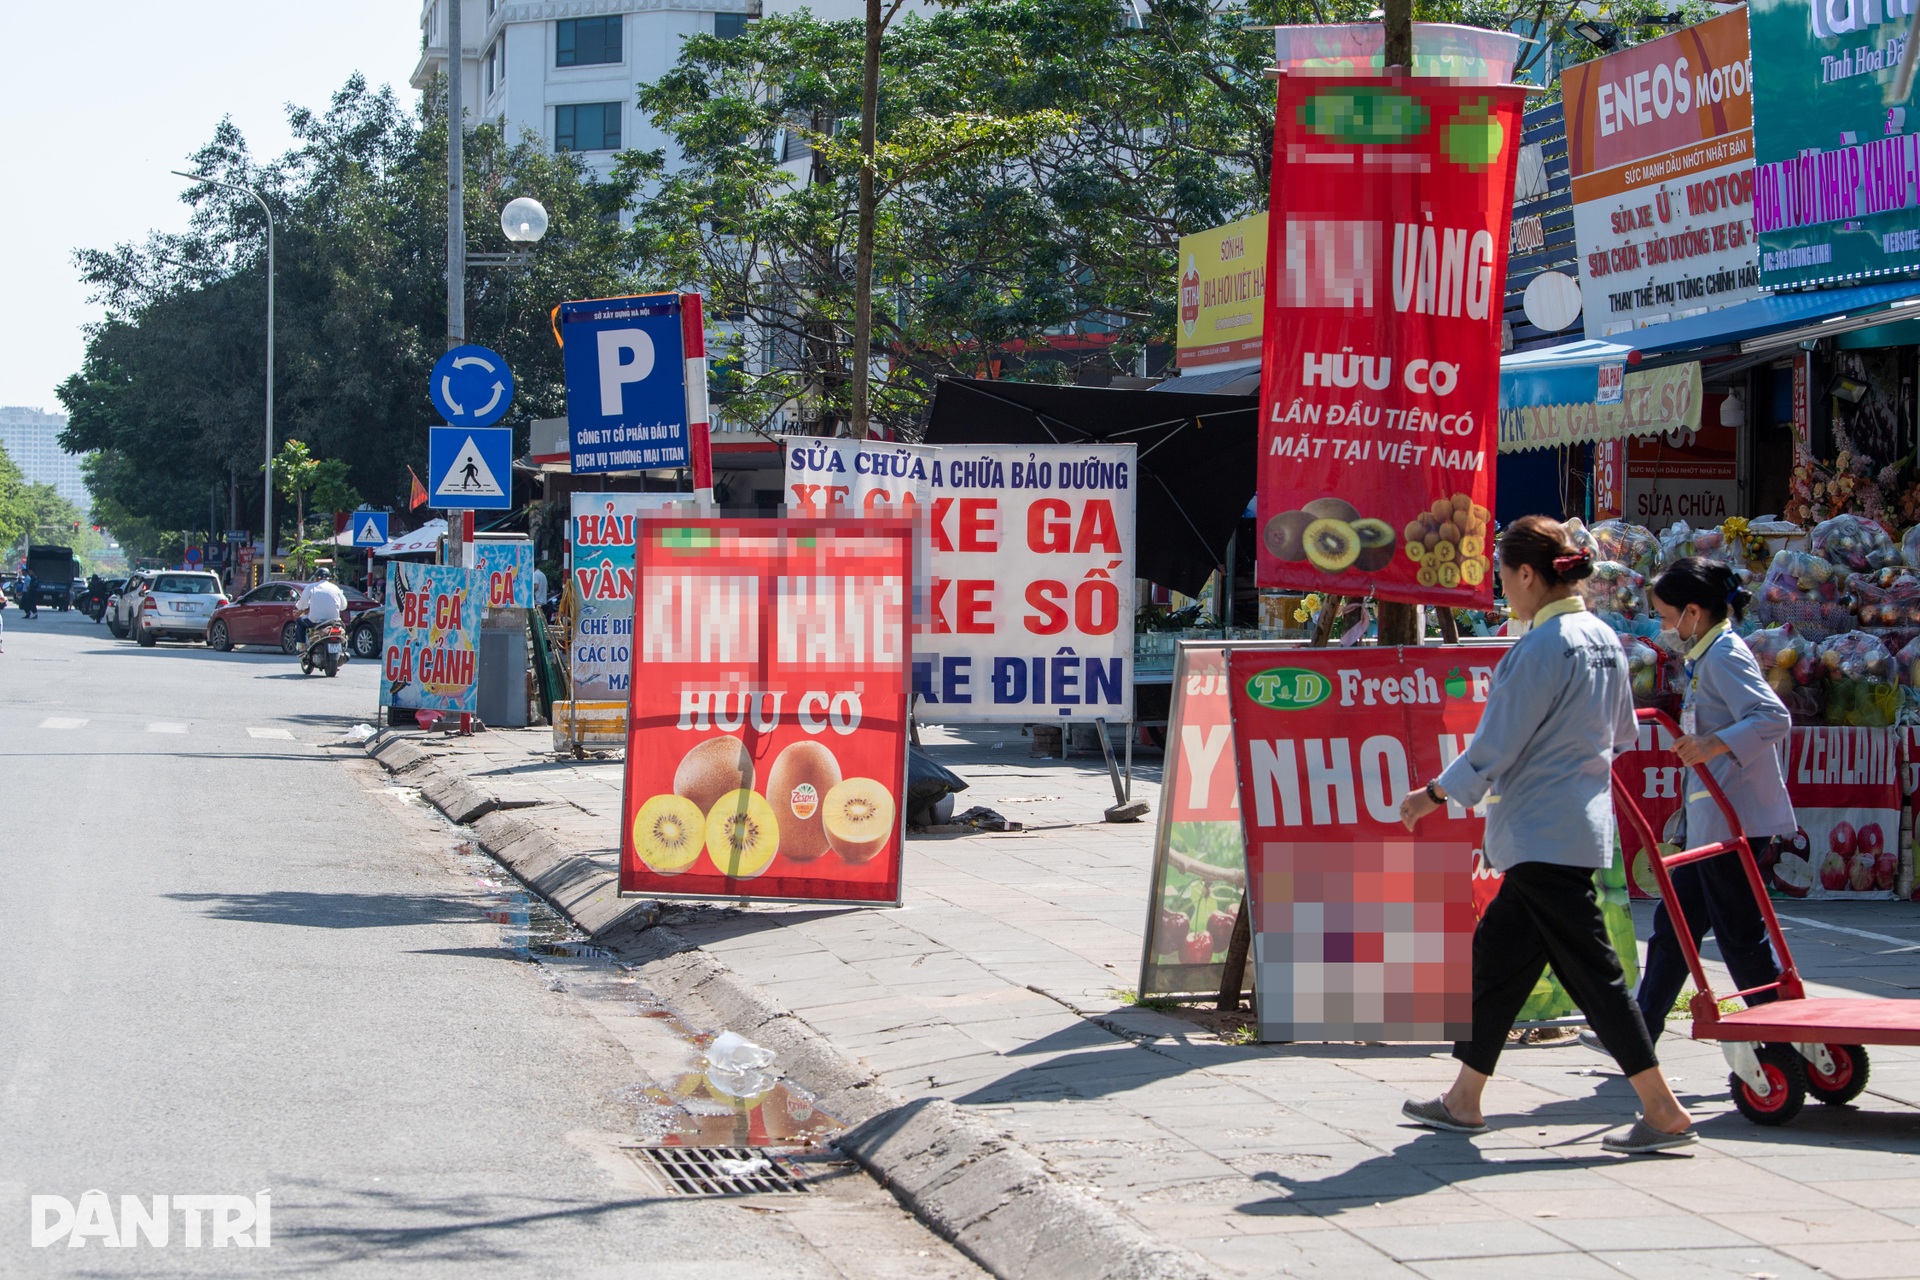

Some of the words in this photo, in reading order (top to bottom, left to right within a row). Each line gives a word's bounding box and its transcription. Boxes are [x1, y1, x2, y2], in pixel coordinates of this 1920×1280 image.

[1821, 48, 1854, 84] Tinh
[1854, 45, 1883, 76] Hoa
[1597, 56, 1691, 137] ENEOS
[1625, 165, 1642, 185] SỨC
[1642, 162, 1665, 182] MẠNH
[1665, 153, 1682, 174] DẦU
[1682, 147, 1705, 169] NHỚT
[1706, 142, 1728, 163] NHẬT
[1729, 136, 1747, 156] BẢN
[1752, 162, 1783, 233] HOA
[1783, 148, 1818, 228] TƯƠI
[1818, 131, 1861, 231] NHẬP
[1611, 204, 1636, 235] SỬA
[1636, 204, 1653, 230] XE
[1391, 210, 1493, 321] VÀNG
[1588, 245, 1611, 279] SỬA
[1611, 239, 1641, 273] CHỮA
[1646, 232, 1669, 266] BẢO
[1668, 225, 1710, 261] DƯỠNG
[1710, 224, 1728, 252] XE
[1728, 220, 1747, 249] GA
[1203, 278, 1216, 308] BIA
[1608, 291, 1634, 313] THAY
[1634, 276, 1656, 308] THẾ
[1655, 282, 1675, 307] PHỤ
[1676, 273, 1704, 301] TÙNG
[1705, 266, 1736, 295] CHÍNH
[596, 328, 656, 416] P
[1302, 346, 1391, 391] HỮU
[1404, 358, 1460, 396] CƠ
[1270, 396, 1322, 424] LẦN
[1325, 399, 1381, 427] ĐẦU
[1385, 406, 1438, 433] TIÊN
[1439, 411, 1475, 436] CÓ
[1531, 404, 1561, 441] XE
[1566, 401, 1600, 436] GA
[1618, 385, 1653, 430] XE
[1660, 361, 1692, 425] SỐ
[577, 428, 601, 446] CÔNG
[601, 429, 612, 444] TY
[613, 423, 625, 443] CỔ
[626, 422, 649, 442] PHẦN
[650, 421, 668, 440] ĐẦU
[668, 422, 680, 439] TƯ
[1269, 433, 1327, 463] MẶT
[1331, 438, 1371, 466] TẠI
[1377, 440, 1428, 470] VIỆT
[1431, 446, 1485, 472] NAM
[576, 453, 595, 470] DỊCH
[596, 452, 608, 469] VỤ
[608, 449, 642, 465] THƯƠNG
[643, 448, 660, 466] MẠI
[660, 446, 684, 462] TITAN
[790, 440, 847, 474] SỬA
[854, 448, 928, 481] CHỮA
[949, 456, 1005, 489] CHỮA
[1011, 453, 1052, 489] BẢO
[1058, 456, 1128, 490] DƯỠNG
[577, 500, 637, 547] HẢI
[1638, 488, 1674, 517] SỬA
[1678, 490, 1726, 517] CHỮA
[1027, 497, 1123, 554] GA
[208, 547, 218, 560] P
[403, 579, 433, 629] BỂ
[435, 587, 462, 631] CÁ
[490, 565, 515, 605] CÁ
[1023, 560, 1124, 635] SỐ
[580, 614, 610, 635] CHẾ
[386, 640, 413, 682] CÁ
[418, 636, 475, 686] CẢNH
[577, 642, 606, 663] CÁC
[991, 646, 1123, 716] ĐIỆN
[1337, 665, 1441, 707] Fresh
[792, 791, 816, 803] Zespri
[1249, 734, 1413, 828] NHO
